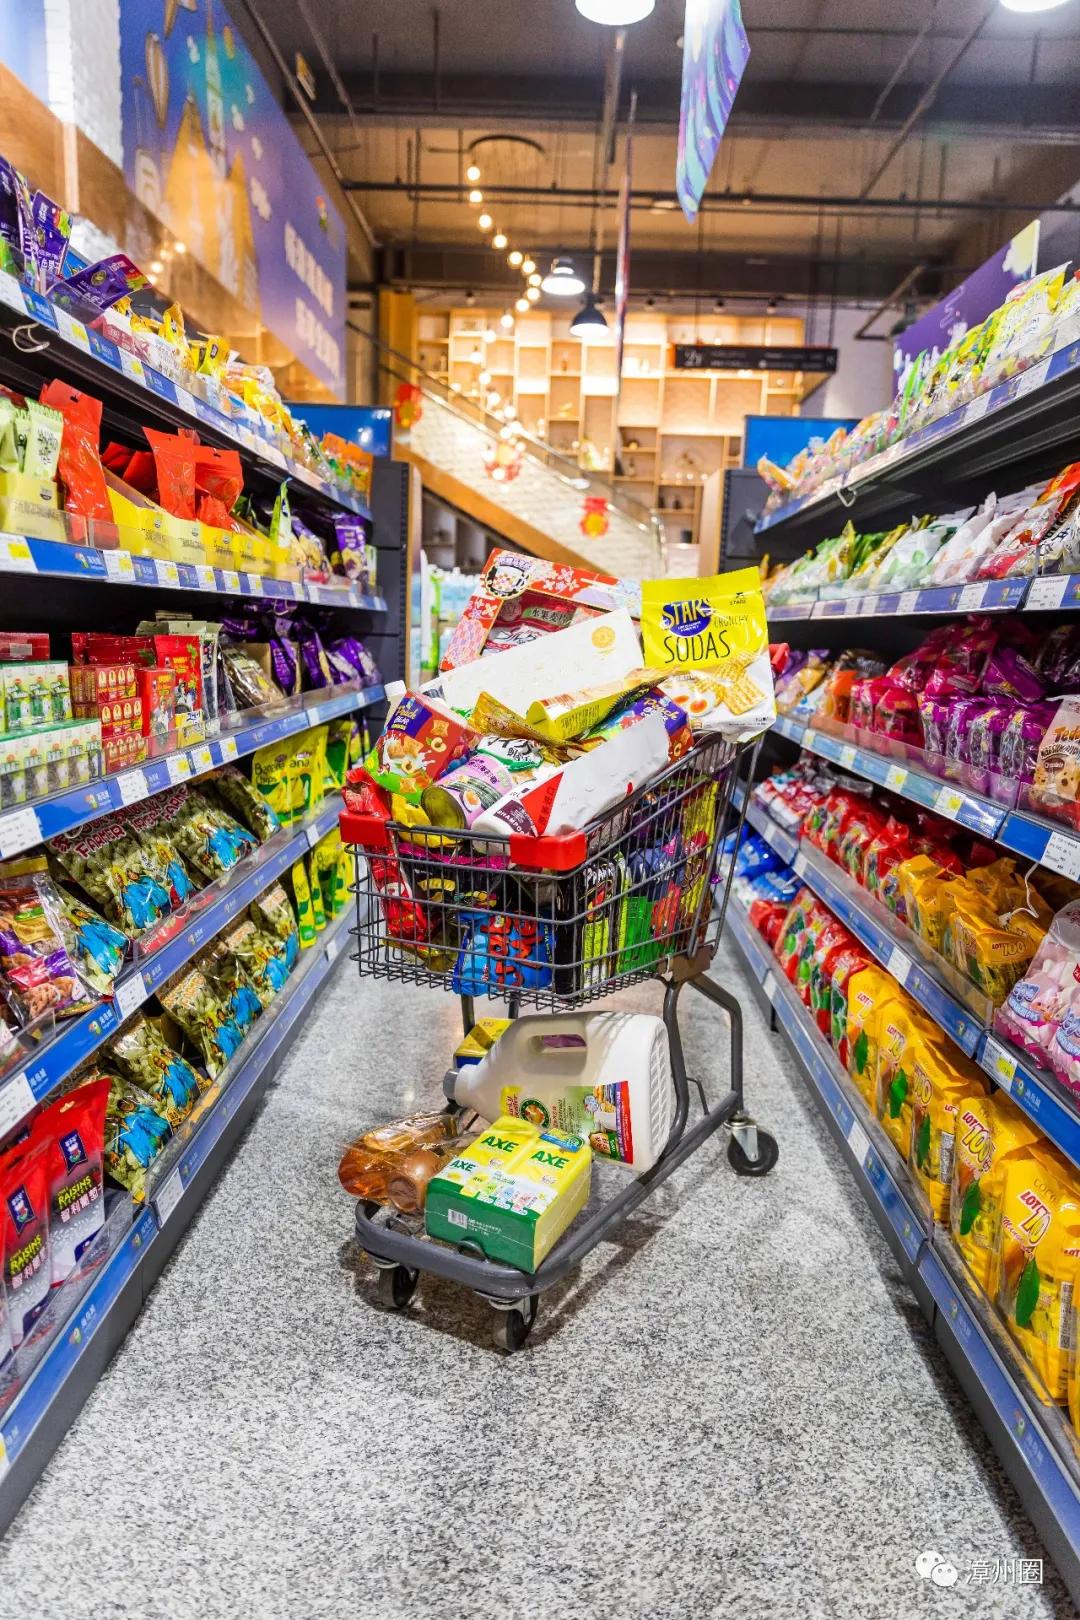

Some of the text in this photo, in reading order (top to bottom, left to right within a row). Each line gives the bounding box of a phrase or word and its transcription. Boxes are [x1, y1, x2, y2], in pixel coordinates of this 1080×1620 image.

[664, 629, 731, 664] SODAS
[1002, 940, 1026, 957] 100
[481, 1135, 519, 1153] AXE
[449, 1159, 478, 1173] AXE
[530, 1150, 570, 1169] AXE
[58, 1175, 92, 1208] RAISINS
[10, 1235, 42, 1275] RAISINS
